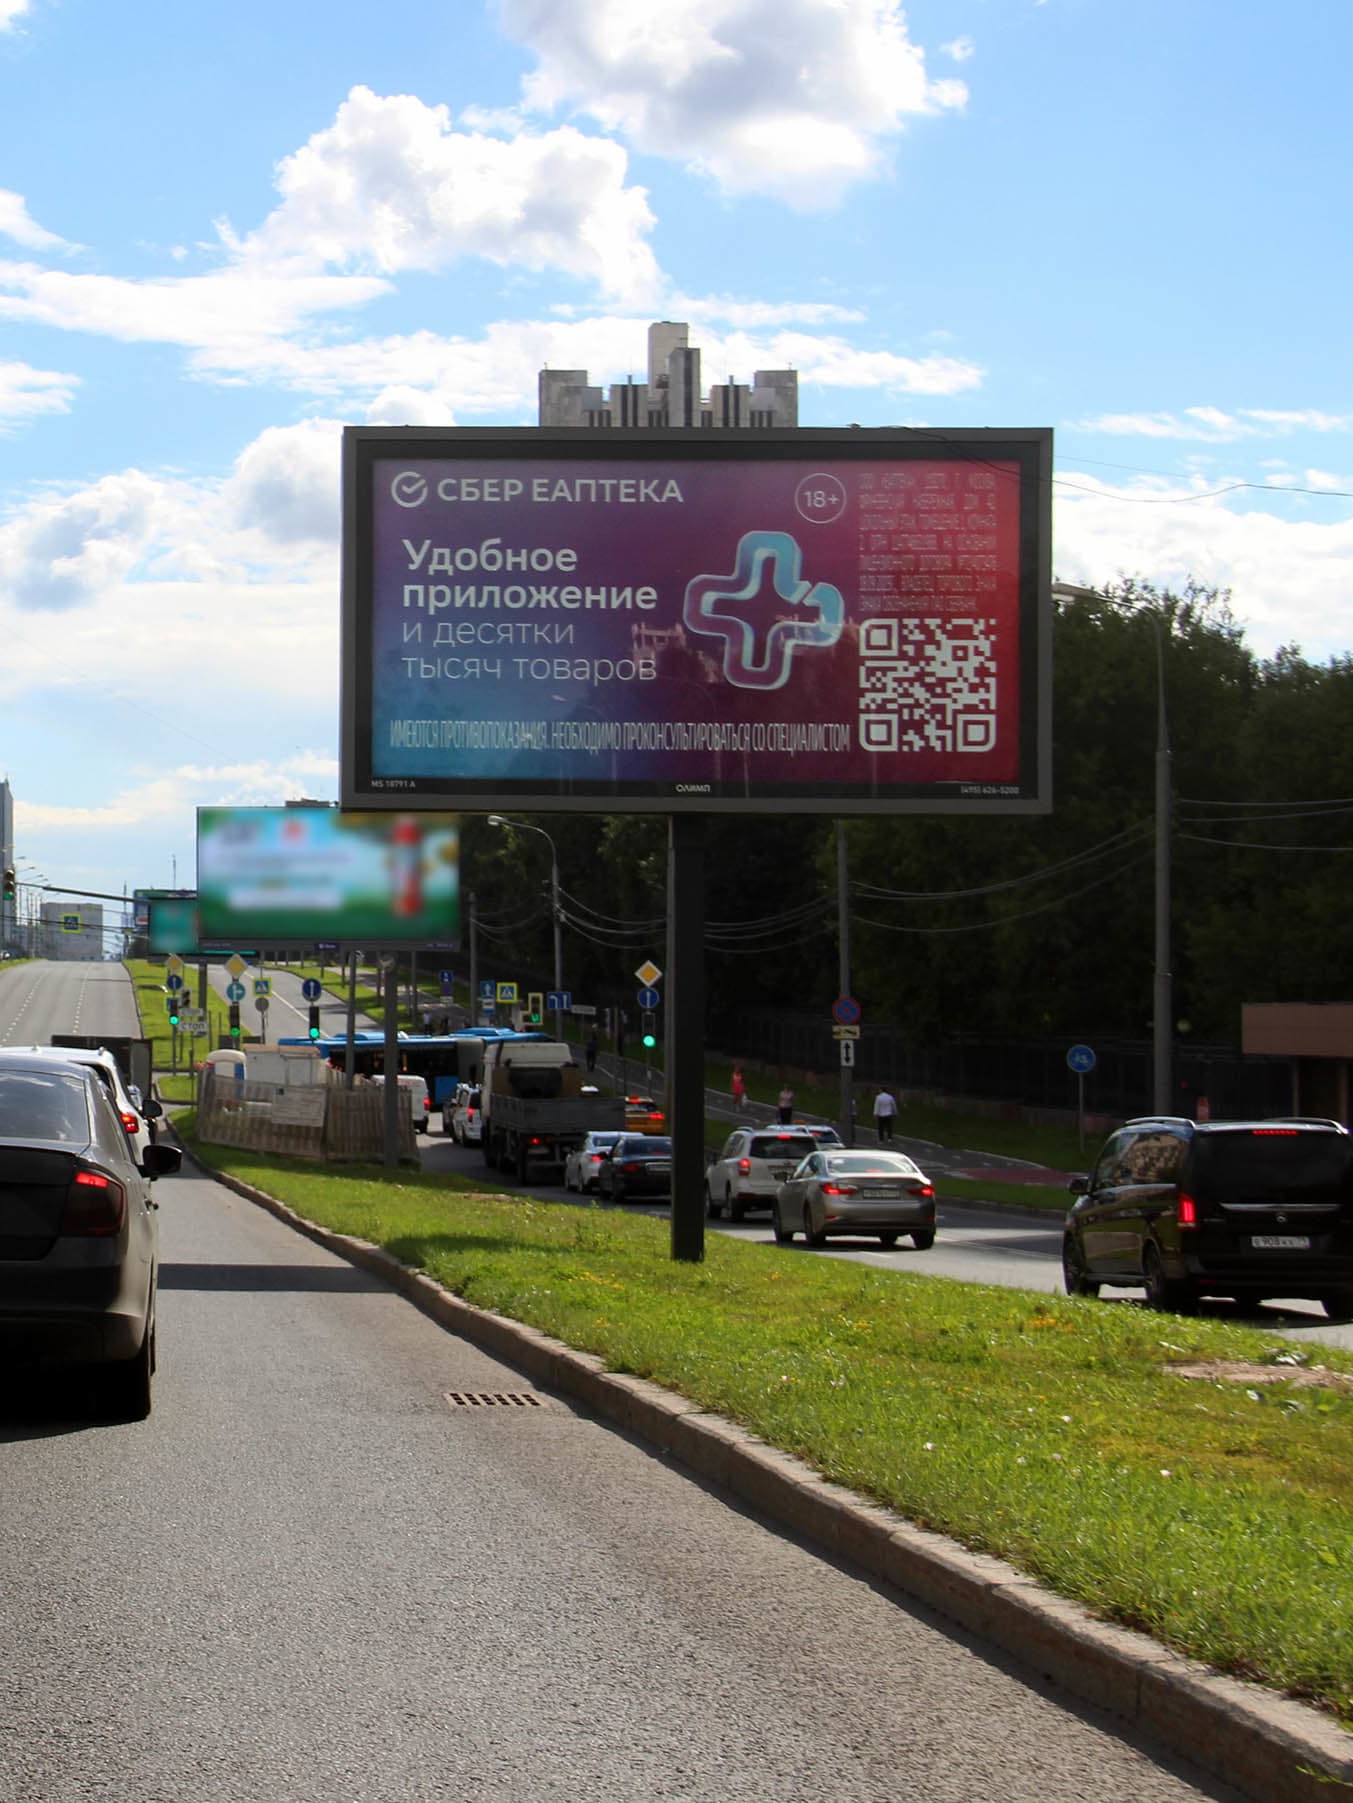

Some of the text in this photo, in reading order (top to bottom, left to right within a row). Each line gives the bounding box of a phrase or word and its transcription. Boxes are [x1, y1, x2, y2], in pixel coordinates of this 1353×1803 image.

[437, 478, 685, 503] СБЕР ЕАПТЕКА
[803, 490, 839, 508] 18+
[401, 538, 578, 575] Удобное
[402, 584, 659, 616] приложение
[402, 622, 575, 648] и десятки
[401, 657, 658, 687] тысяч товаров
[389, 719, 438, 748] ИМЕЮТСЯ
[551, 720, 621, 754] НЕОБХОДИМО
[752, 722, 766, 751] СО
[767, 722, 851, 757] СПЕЦИАЛИСТОМ
